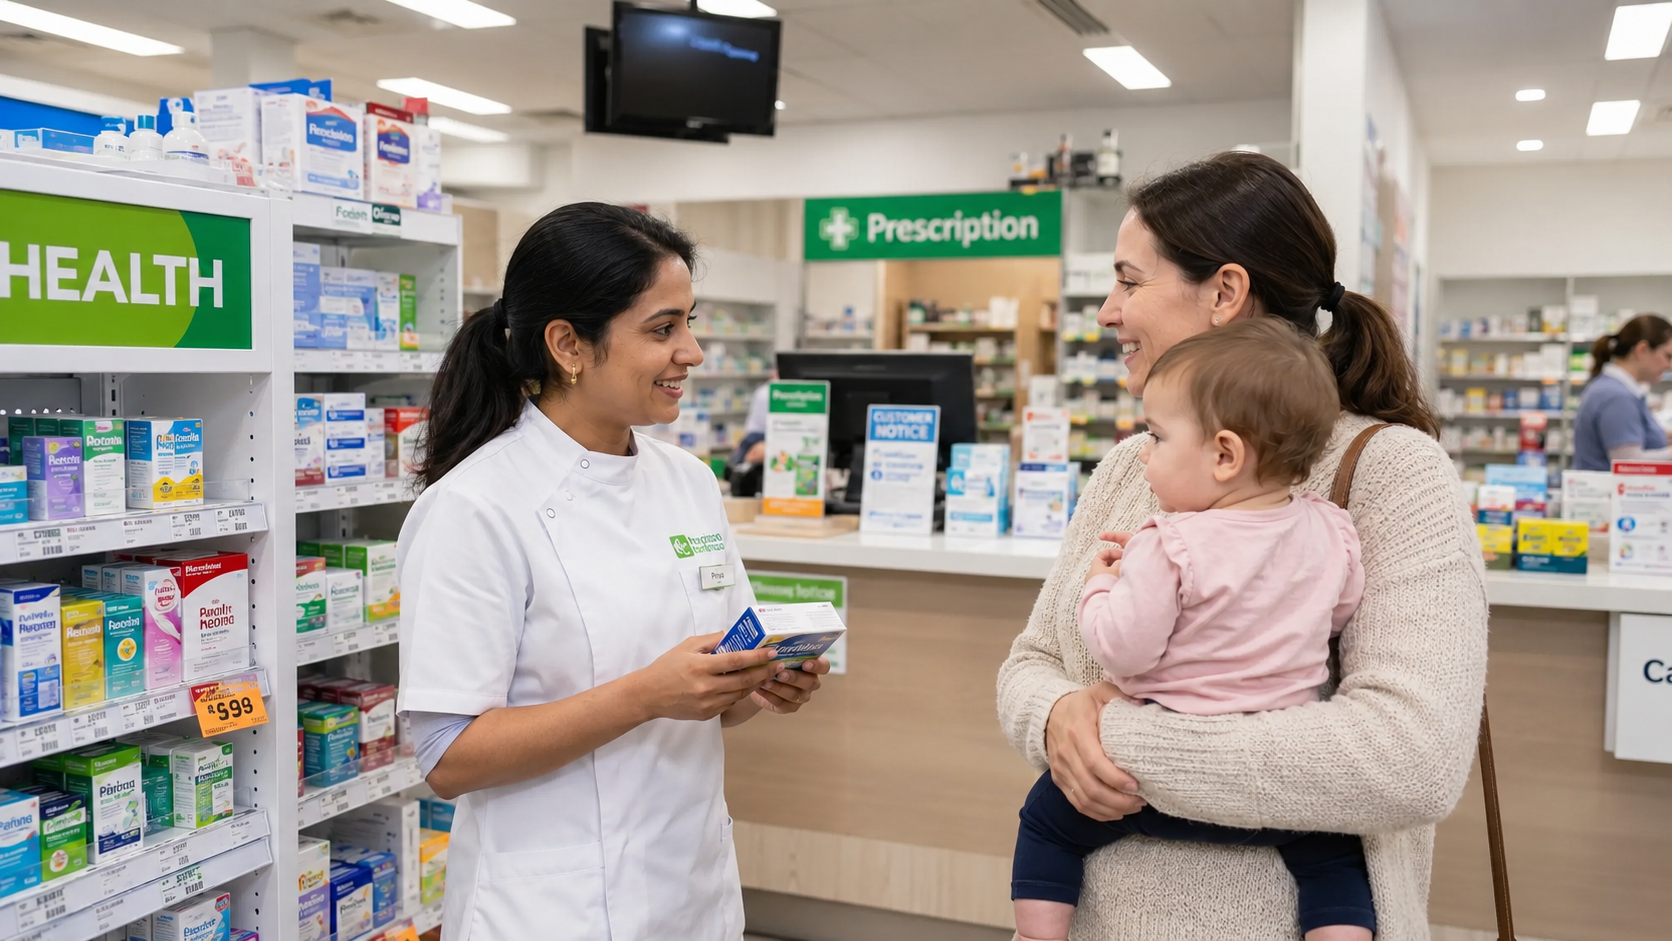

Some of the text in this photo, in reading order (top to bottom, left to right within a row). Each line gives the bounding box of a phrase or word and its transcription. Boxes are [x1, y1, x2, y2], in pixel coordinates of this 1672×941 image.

[867, 208, 1038, 248] Prescription
[0, 241, 223, 308] HEALTH
[873, 410, 933, 424] CUSTOMER
[875, 424, 930, 440] NOTICE
